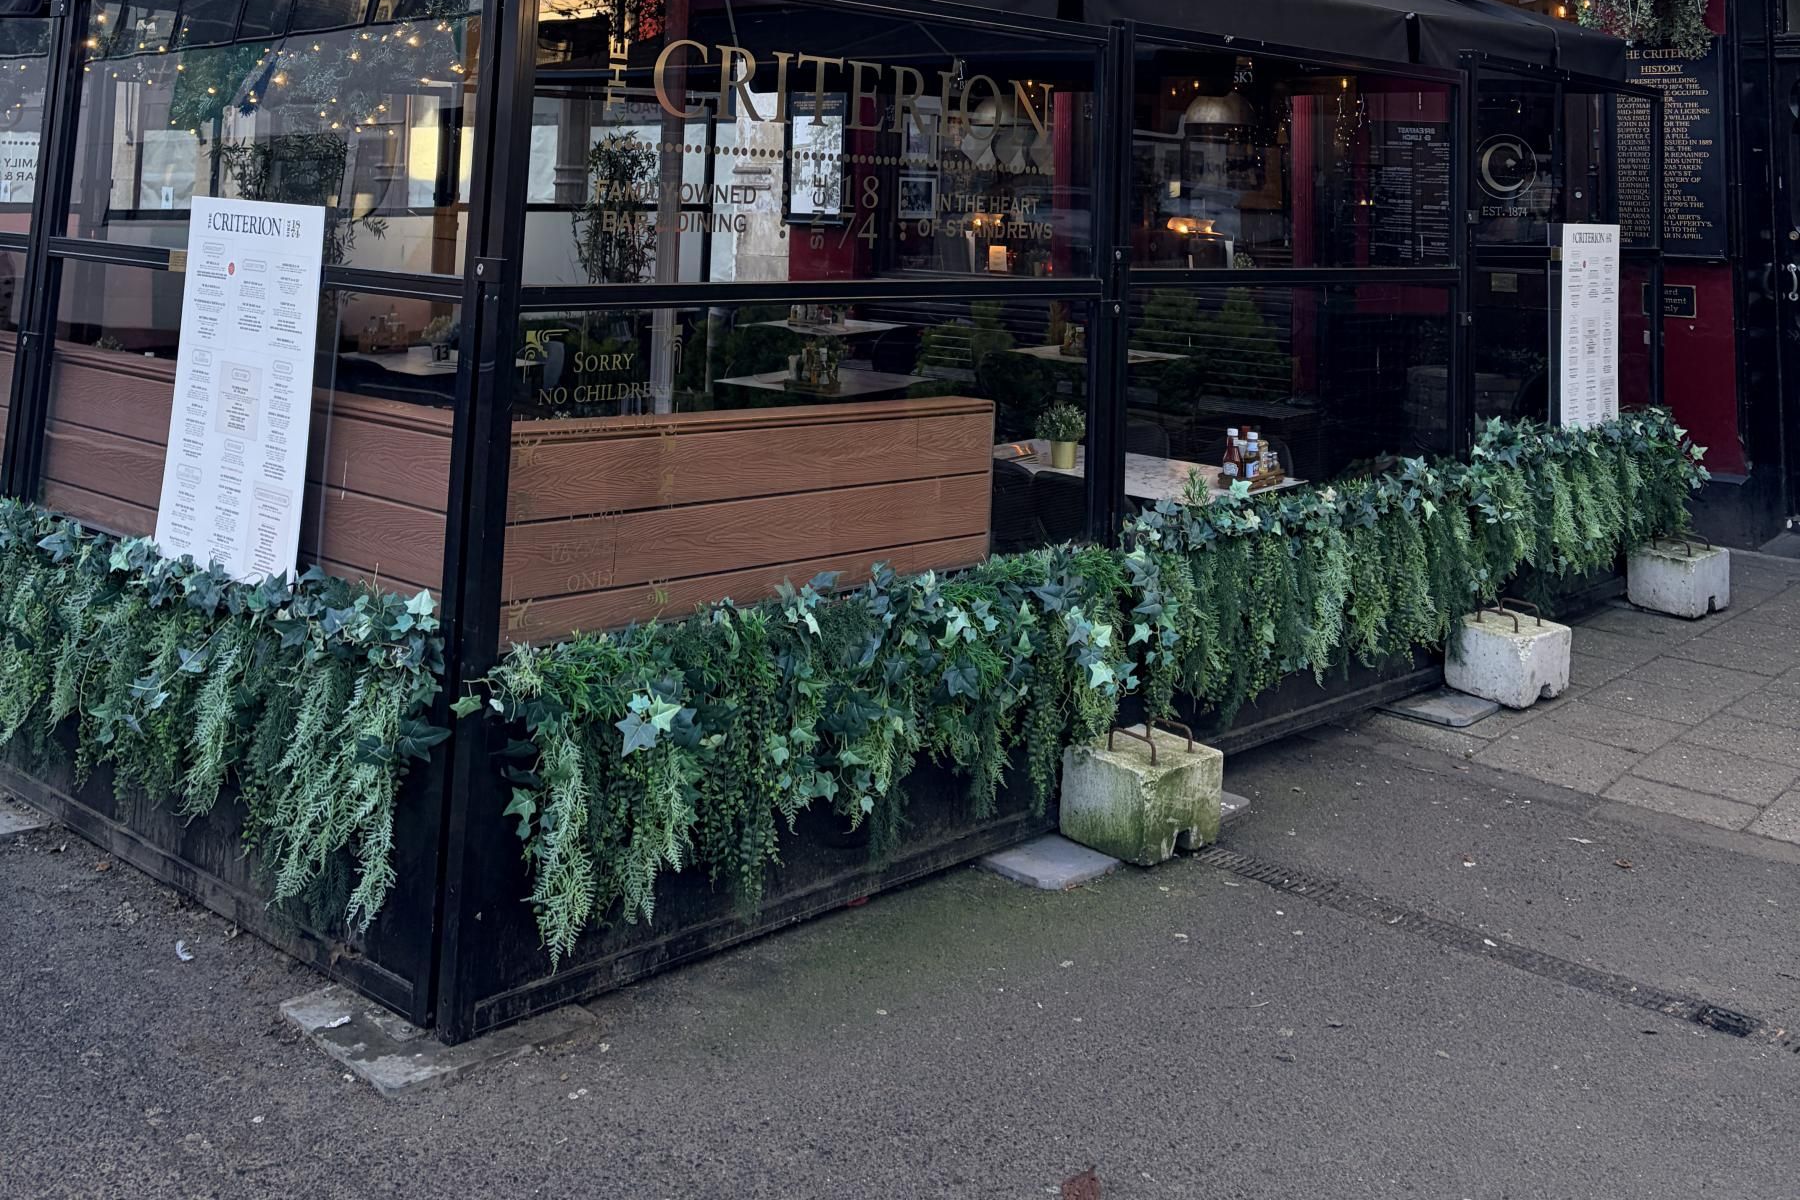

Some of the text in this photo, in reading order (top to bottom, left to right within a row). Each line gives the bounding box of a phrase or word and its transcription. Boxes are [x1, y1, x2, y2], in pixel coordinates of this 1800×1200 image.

[1626, 50, 1641, 59] HE
[606, 35, 629, 112] THE
[1641, 64, 1684, 73] HISTORY
[653, 39, 1055, 145] CRITERION
[594, 178, 757, 205] FAMILY OWNED
[810, 173, 828, 249] SINCE
[936, 194, 1040, 215] IN THE HEART
[1509, 206, 1528, 217] 1874
[213, 211, 282, 237] CRITERION
[602, 210, 649, 233] BAR
[677, 212, 747, 233] DINING
[917, 219, 941, 237] OF
[971, 221, 1053, 240] ANDREWS
[573, 351, 634, 374] SORRY
[537, 381, 668, 406] NO CHILDREN
